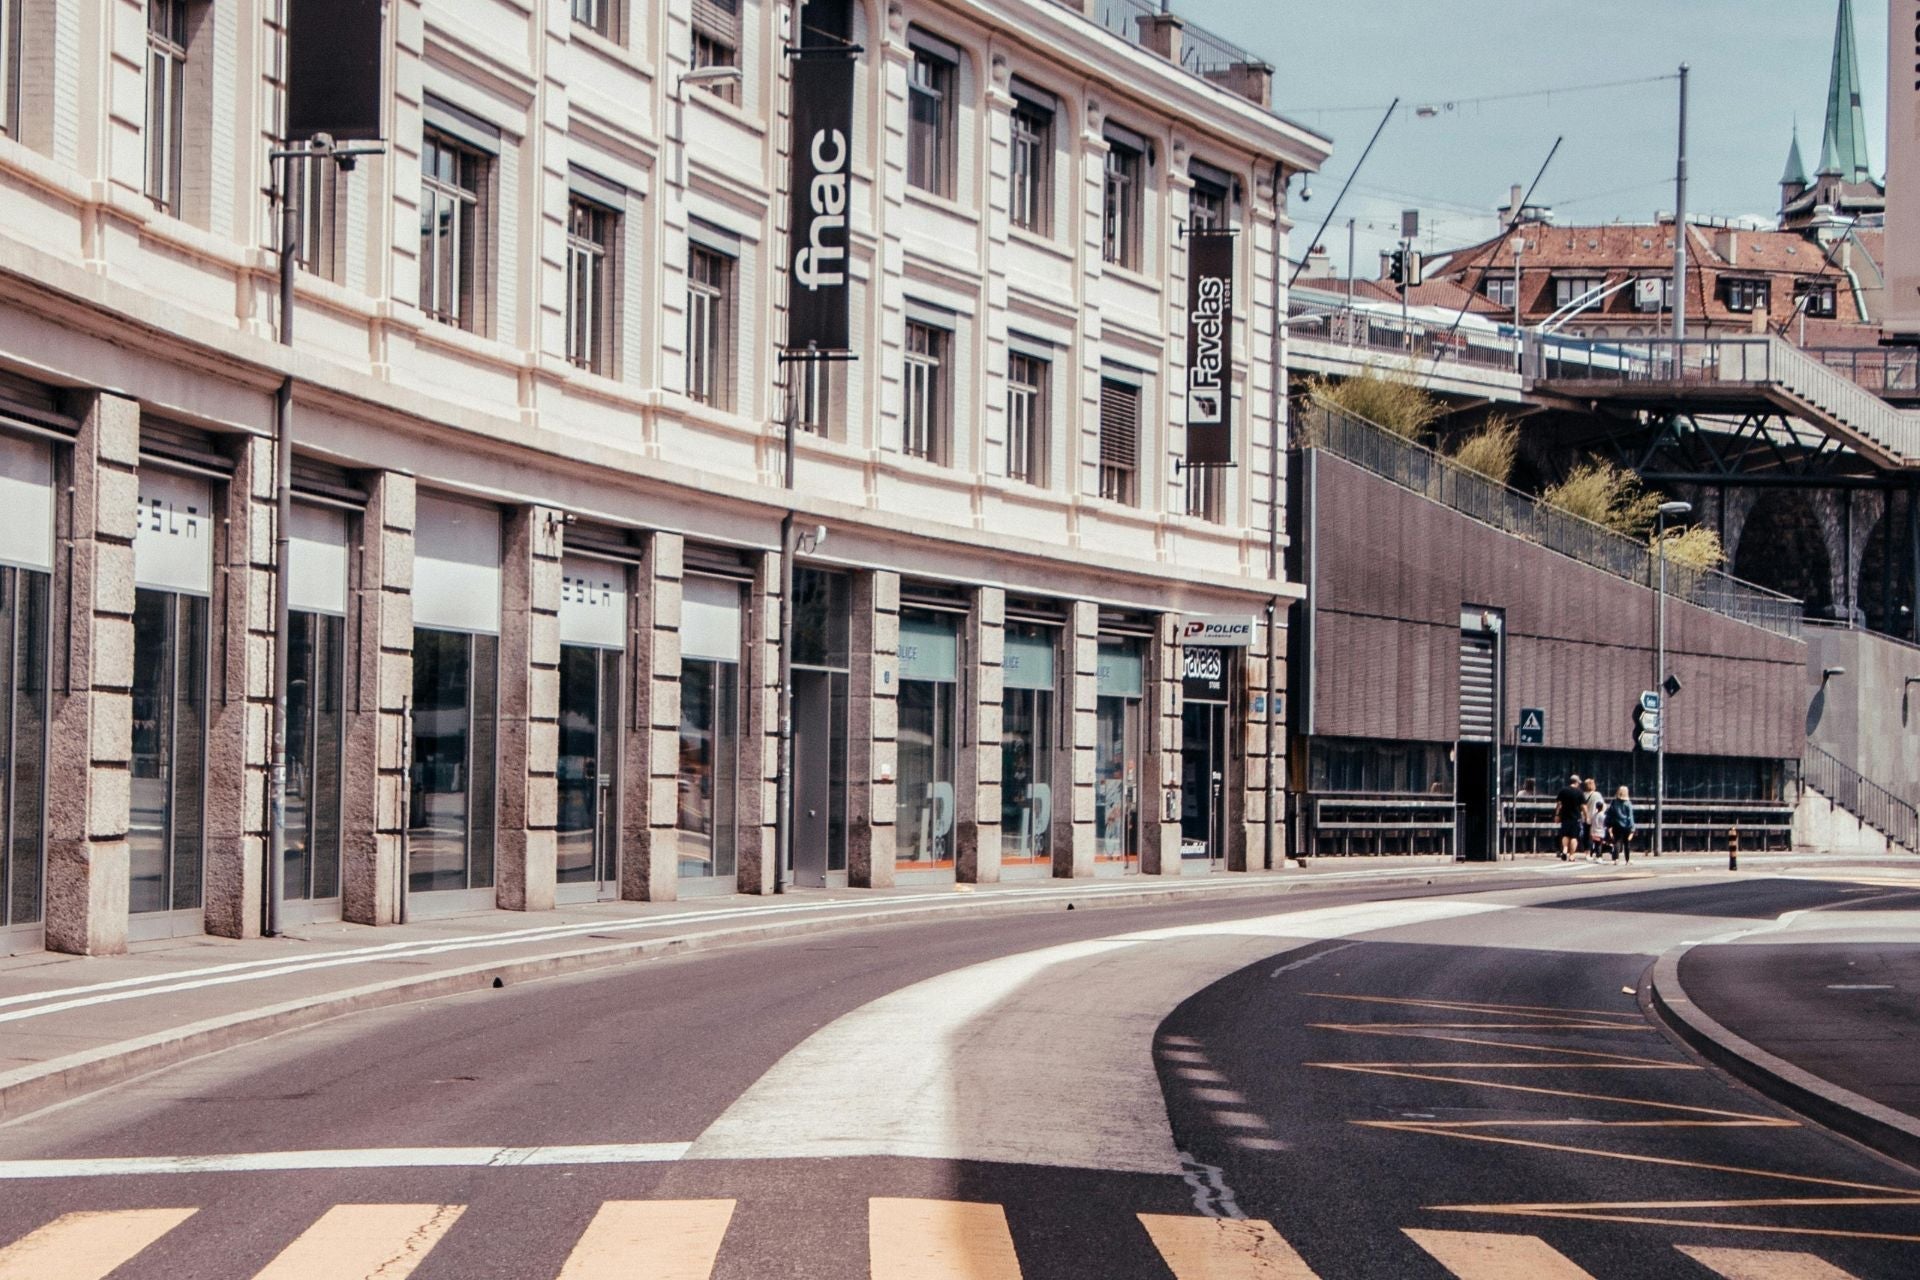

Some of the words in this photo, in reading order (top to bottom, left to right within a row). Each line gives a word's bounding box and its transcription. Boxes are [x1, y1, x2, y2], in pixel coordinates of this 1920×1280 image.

[795, 129, 846, 291] fnac
[1190, 277, 1223, 390] Favelas
[1205, 624, 1249, 633] POLICE
